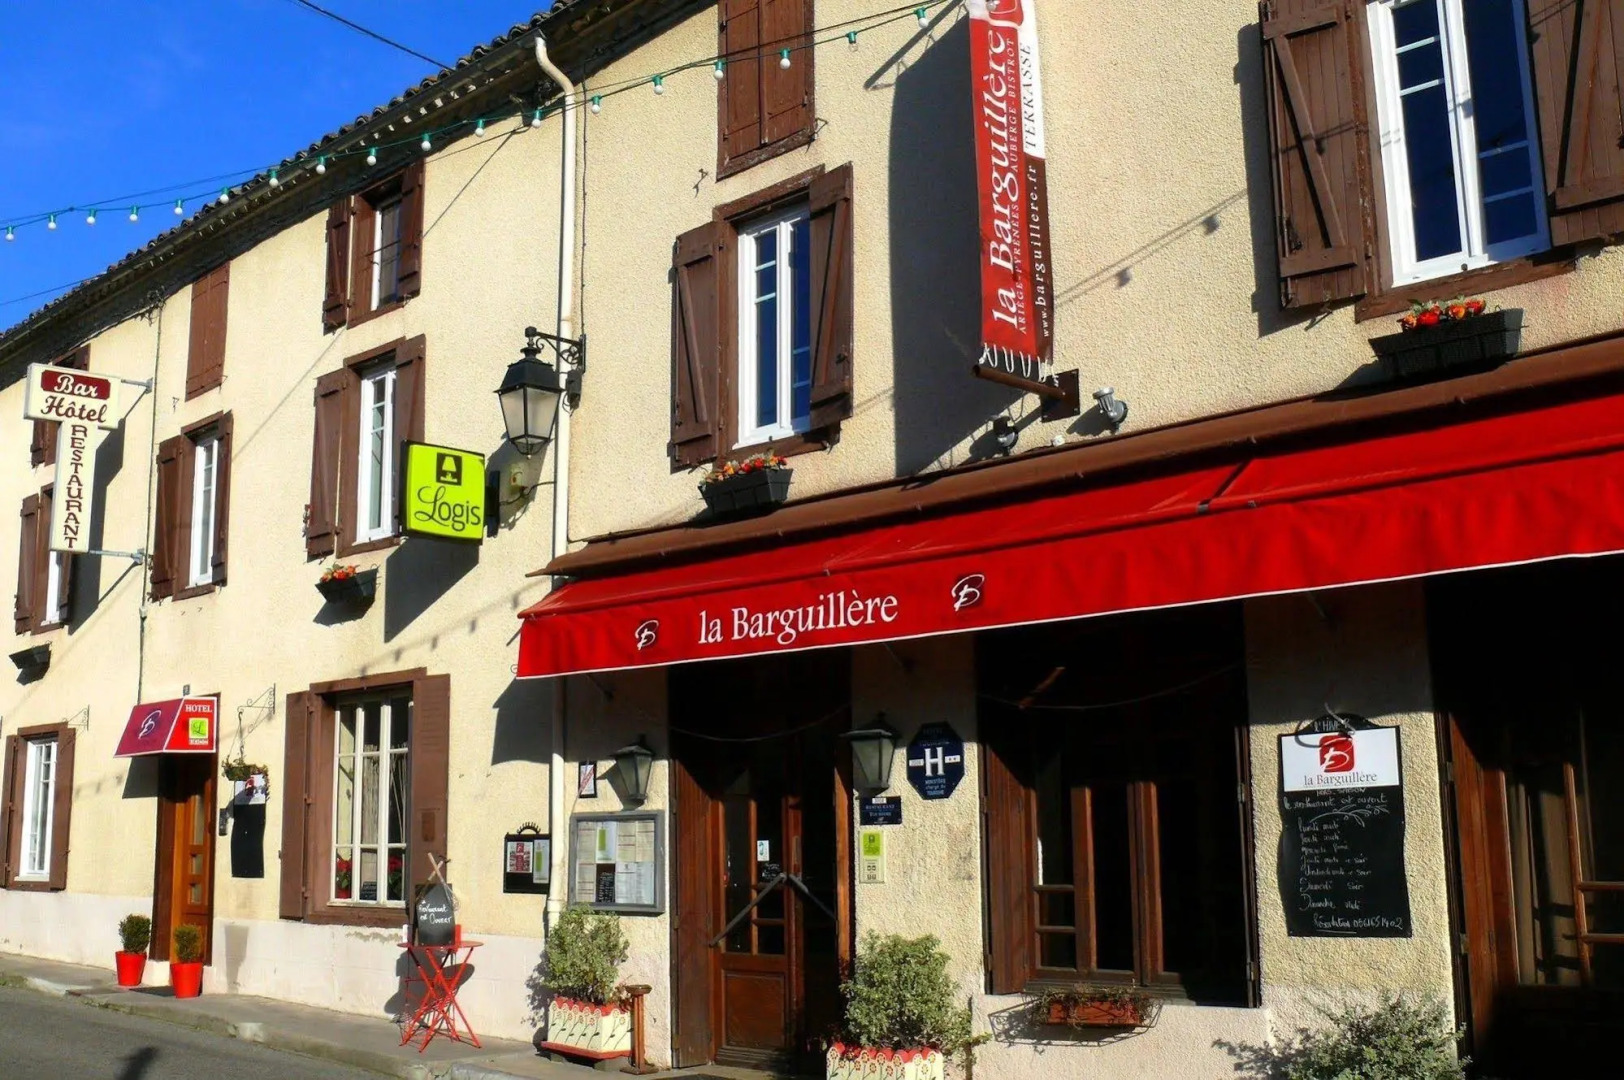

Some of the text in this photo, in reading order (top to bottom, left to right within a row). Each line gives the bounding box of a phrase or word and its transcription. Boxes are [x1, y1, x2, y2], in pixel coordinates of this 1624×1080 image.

[1020, 42, 1036, 149] TERRASSE
[983, 30, 1018, 329] la Barguillère
[1027, 165, 1050, 337] www.barguillere.fr
[40, 395, 107, 423] Hôtel
[54, 374, 98, 397] Bar
[63, 424, 88, 548] RESTAURANT
[414, 485, 481, 532] Logis
[698, 590, 898, 646] la Barguillère
[924, 747, 945, 777] H
[1303, 775, 1314, 786] la
[1316, 771, 1377, 787] Barguillère
